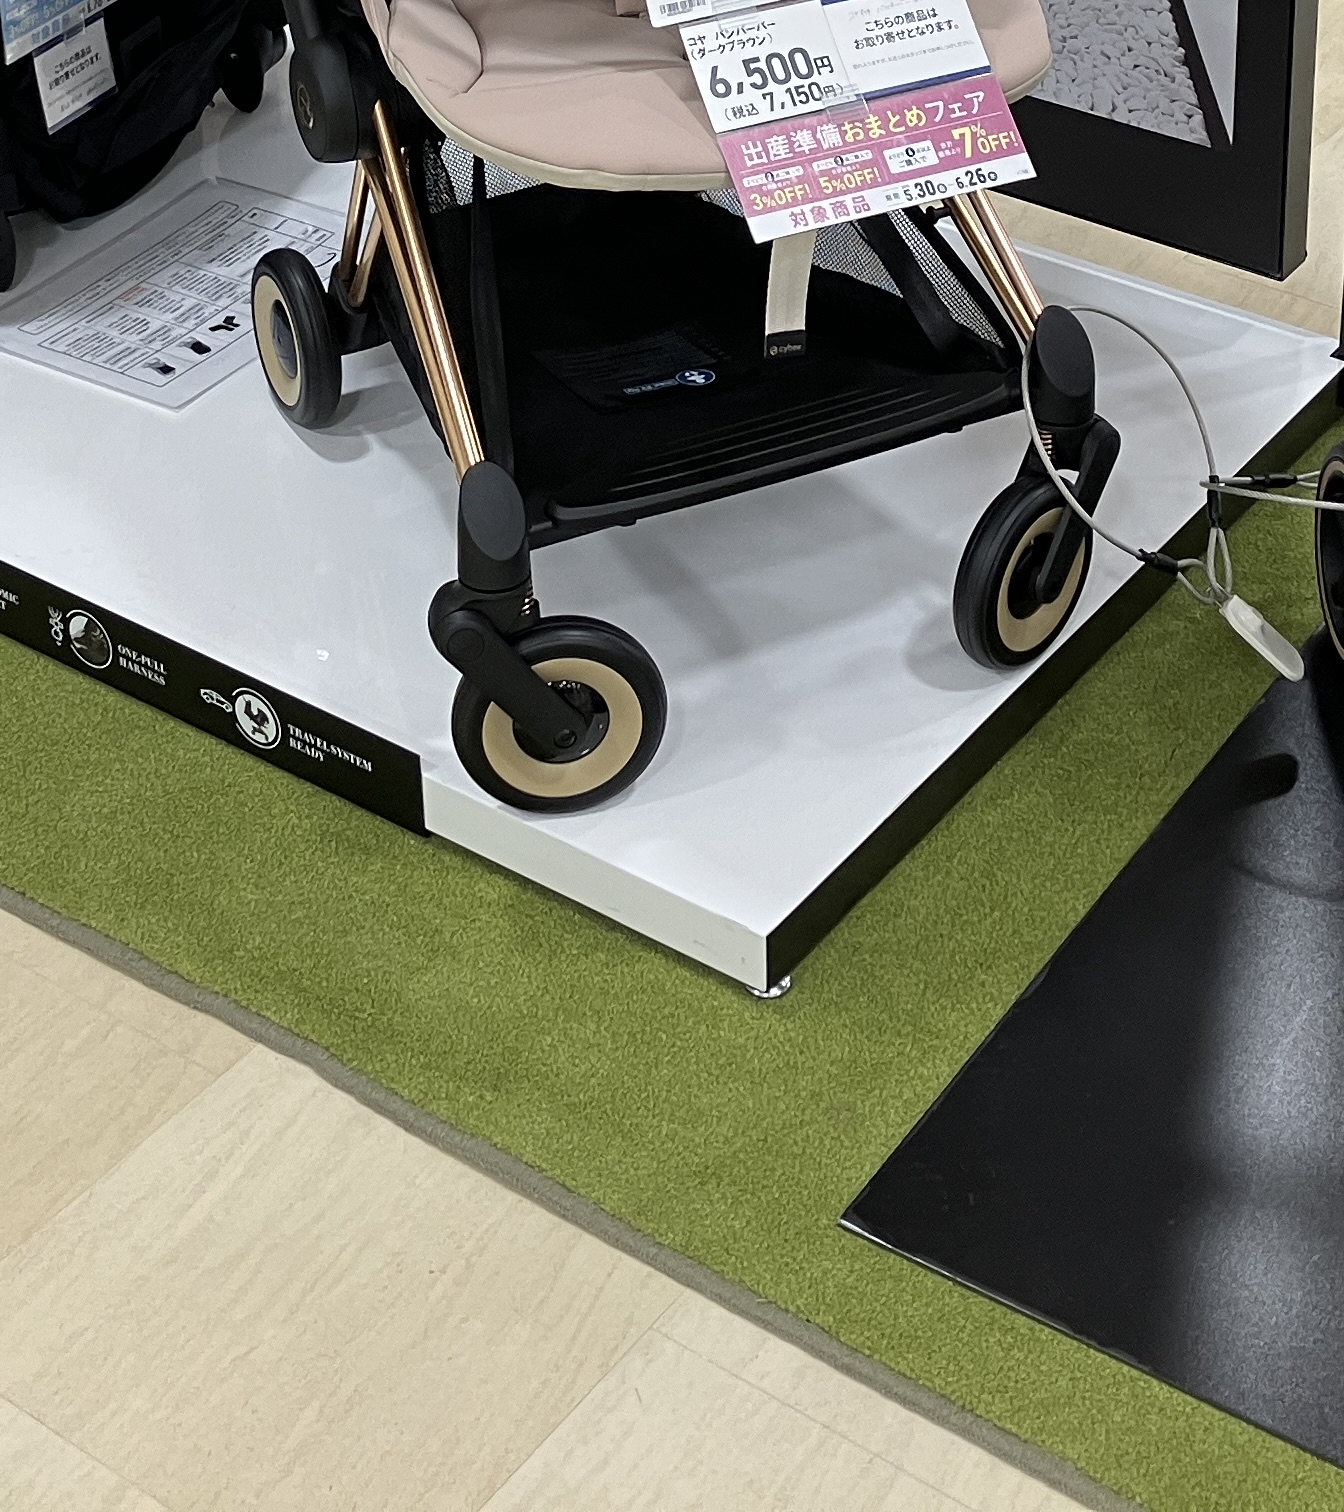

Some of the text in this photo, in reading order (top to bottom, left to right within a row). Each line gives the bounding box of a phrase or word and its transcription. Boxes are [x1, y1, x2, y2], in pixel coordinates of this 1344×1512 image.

[852, 18, 961, 51] お取り寄せとなります。
[863, 6, 939, 33] こちらの商品は
[708, 46, 836, 100] 6,500円
[739, 90, 986, 168] 出産準備おまとめフェア
[749, 183, 814, 212] 3%OFF!
[817, 167, 883, 196] 5%OFF!
[789, 194, 872, 230] 対象商品
[116, 643, 168, 676] ONE-PULL
[118, 655, 167, 687] HARNESS
[286, 722, 374, 774] TRAVEL SYSTEM
[288, 736, 326, 763] READY
